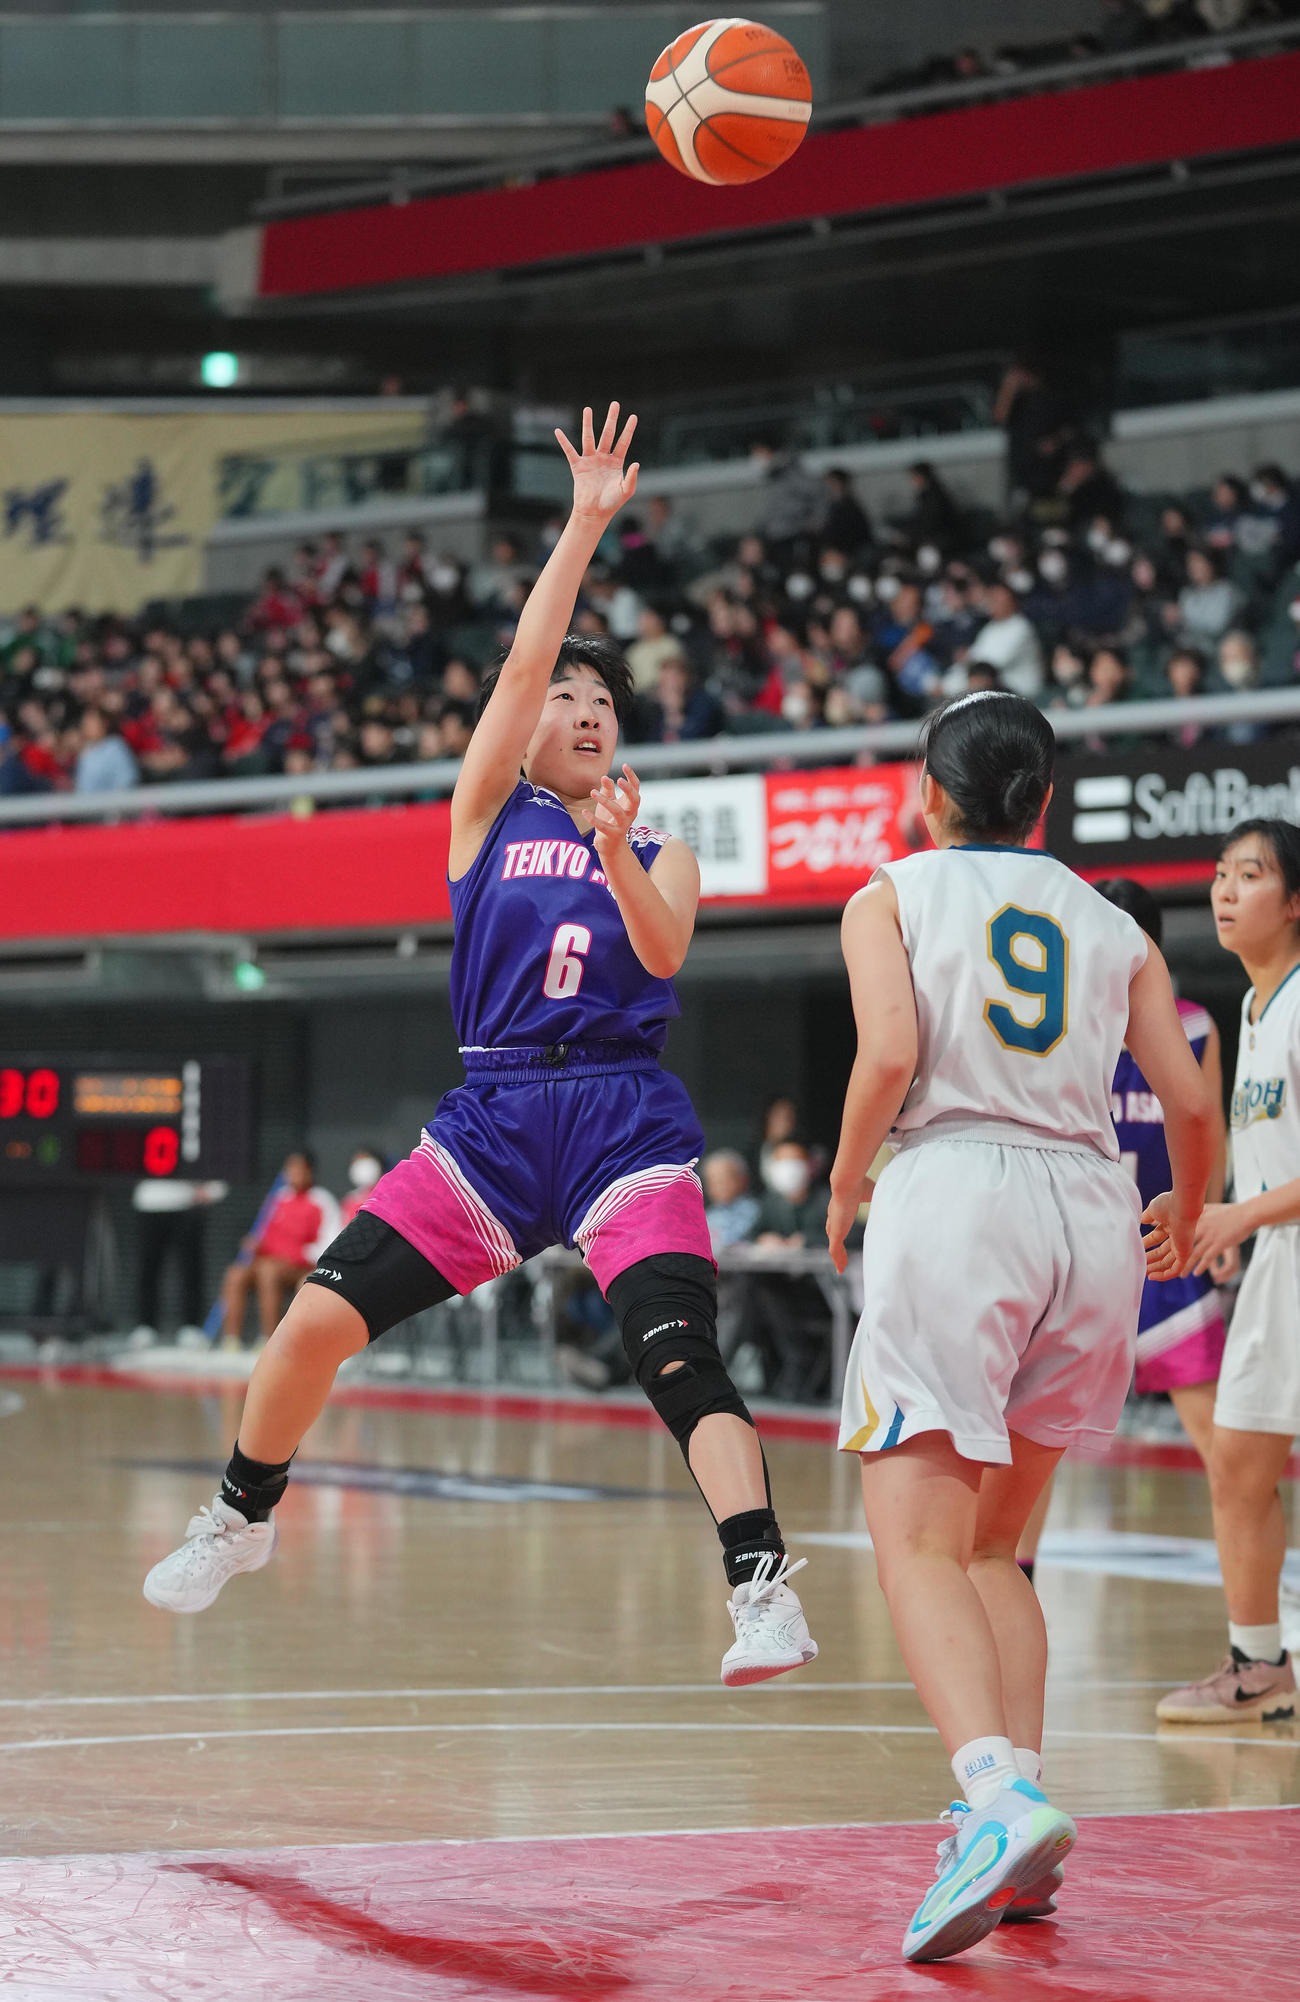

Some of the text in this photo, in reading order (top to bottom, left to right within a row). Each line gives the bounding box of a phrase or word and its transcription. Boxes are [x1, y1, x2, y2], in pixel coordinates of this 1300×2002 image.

[501, 839, 591, 881] TEIKYO
[543, 922, 593, 999] 6
[983, 902, 1070, 1058] 9
[143, 1125, 180, 1177] 0
